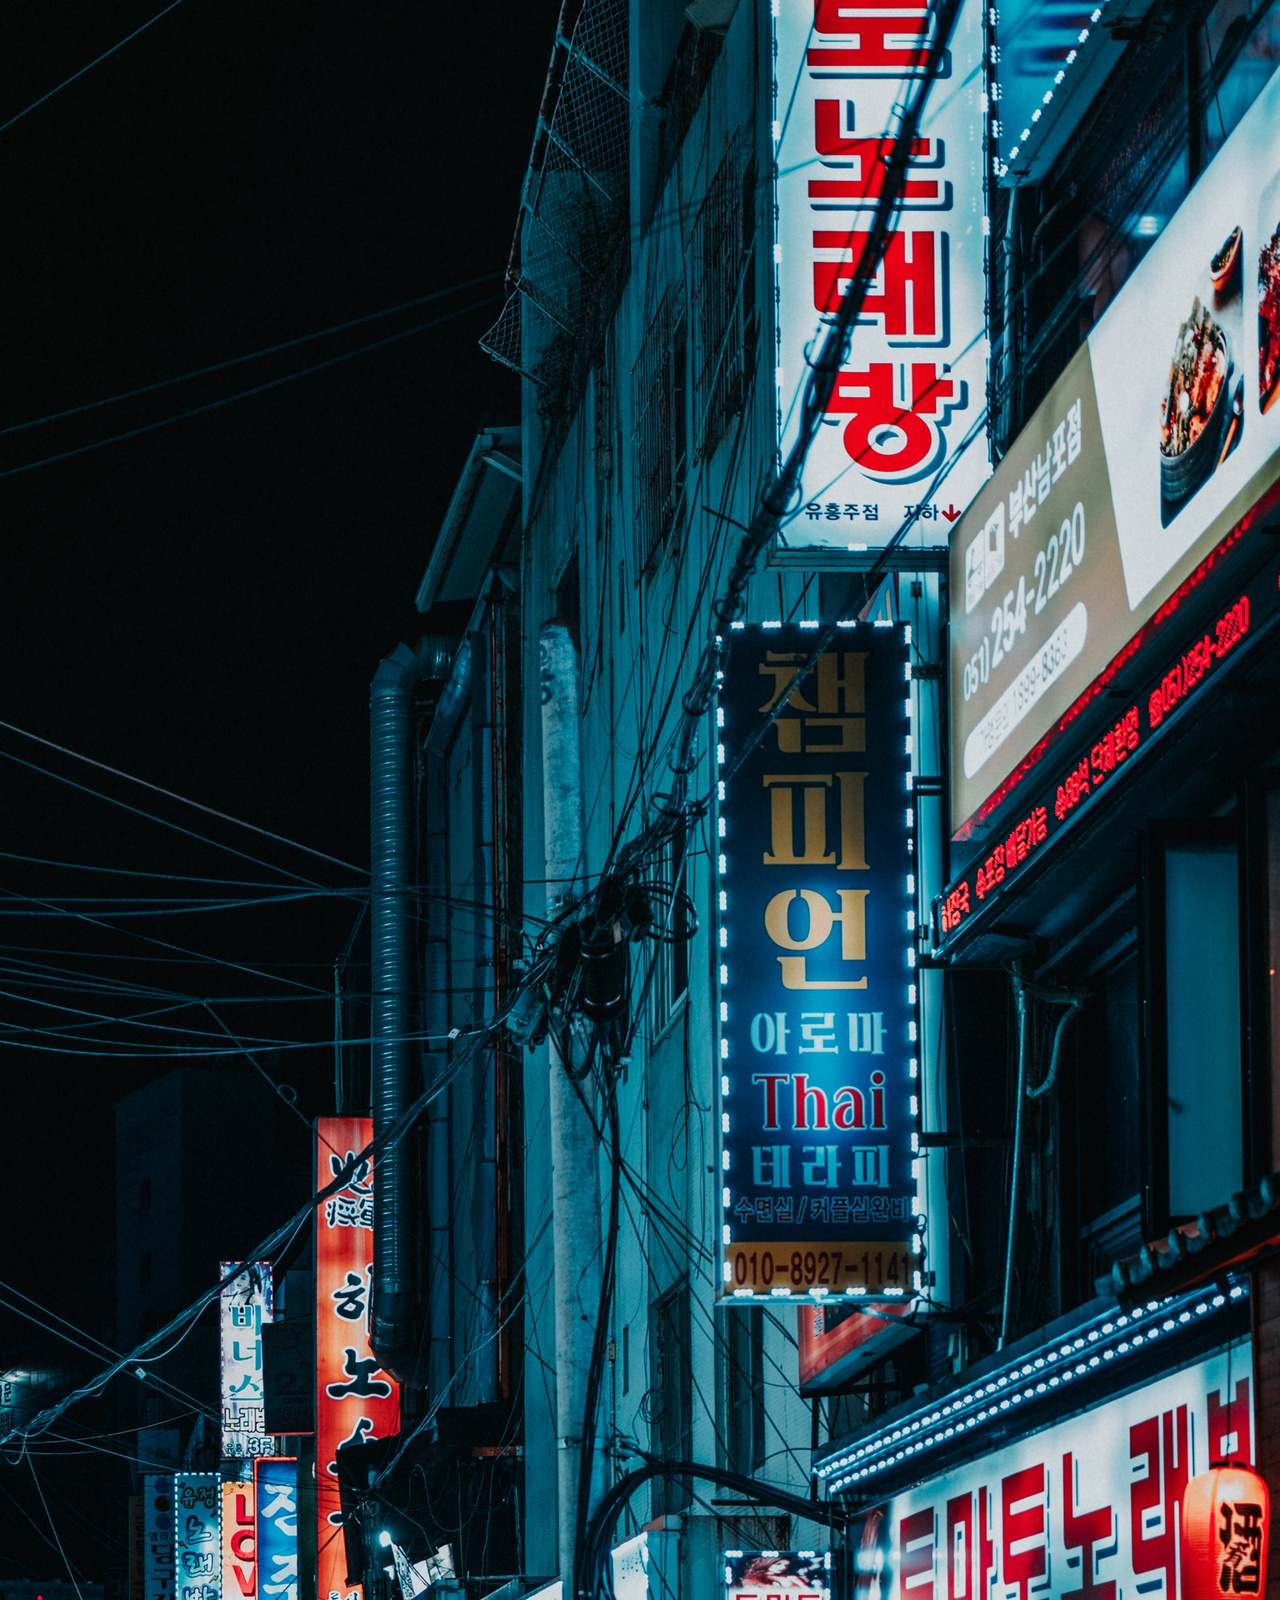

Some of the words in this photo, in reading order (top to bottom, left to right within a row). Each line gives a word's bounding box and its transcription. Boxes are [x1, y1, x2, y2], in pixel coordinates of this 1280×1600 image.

[1008, 396, 1082, 540] 부산남포점
[805, 503, 880, 523] 유흥주점
[904, 502, 940, 523] 지하
[990, 501, 1086, 670] 254-2220
[758, 649, 871, 990] 챔피언
[750, 1011, 888, 1055] 아로마
[752, 1070, 888, 1131] Thai
[751, 1144, 891, 1189] 테라피
[733, 1251, 910, 1286] 010-8927-1141
[228, 1304, 264, 1401] 비너스
[248, 1437, 273, 1455] 3F
[181, 1487, 217, 1510] 유정
